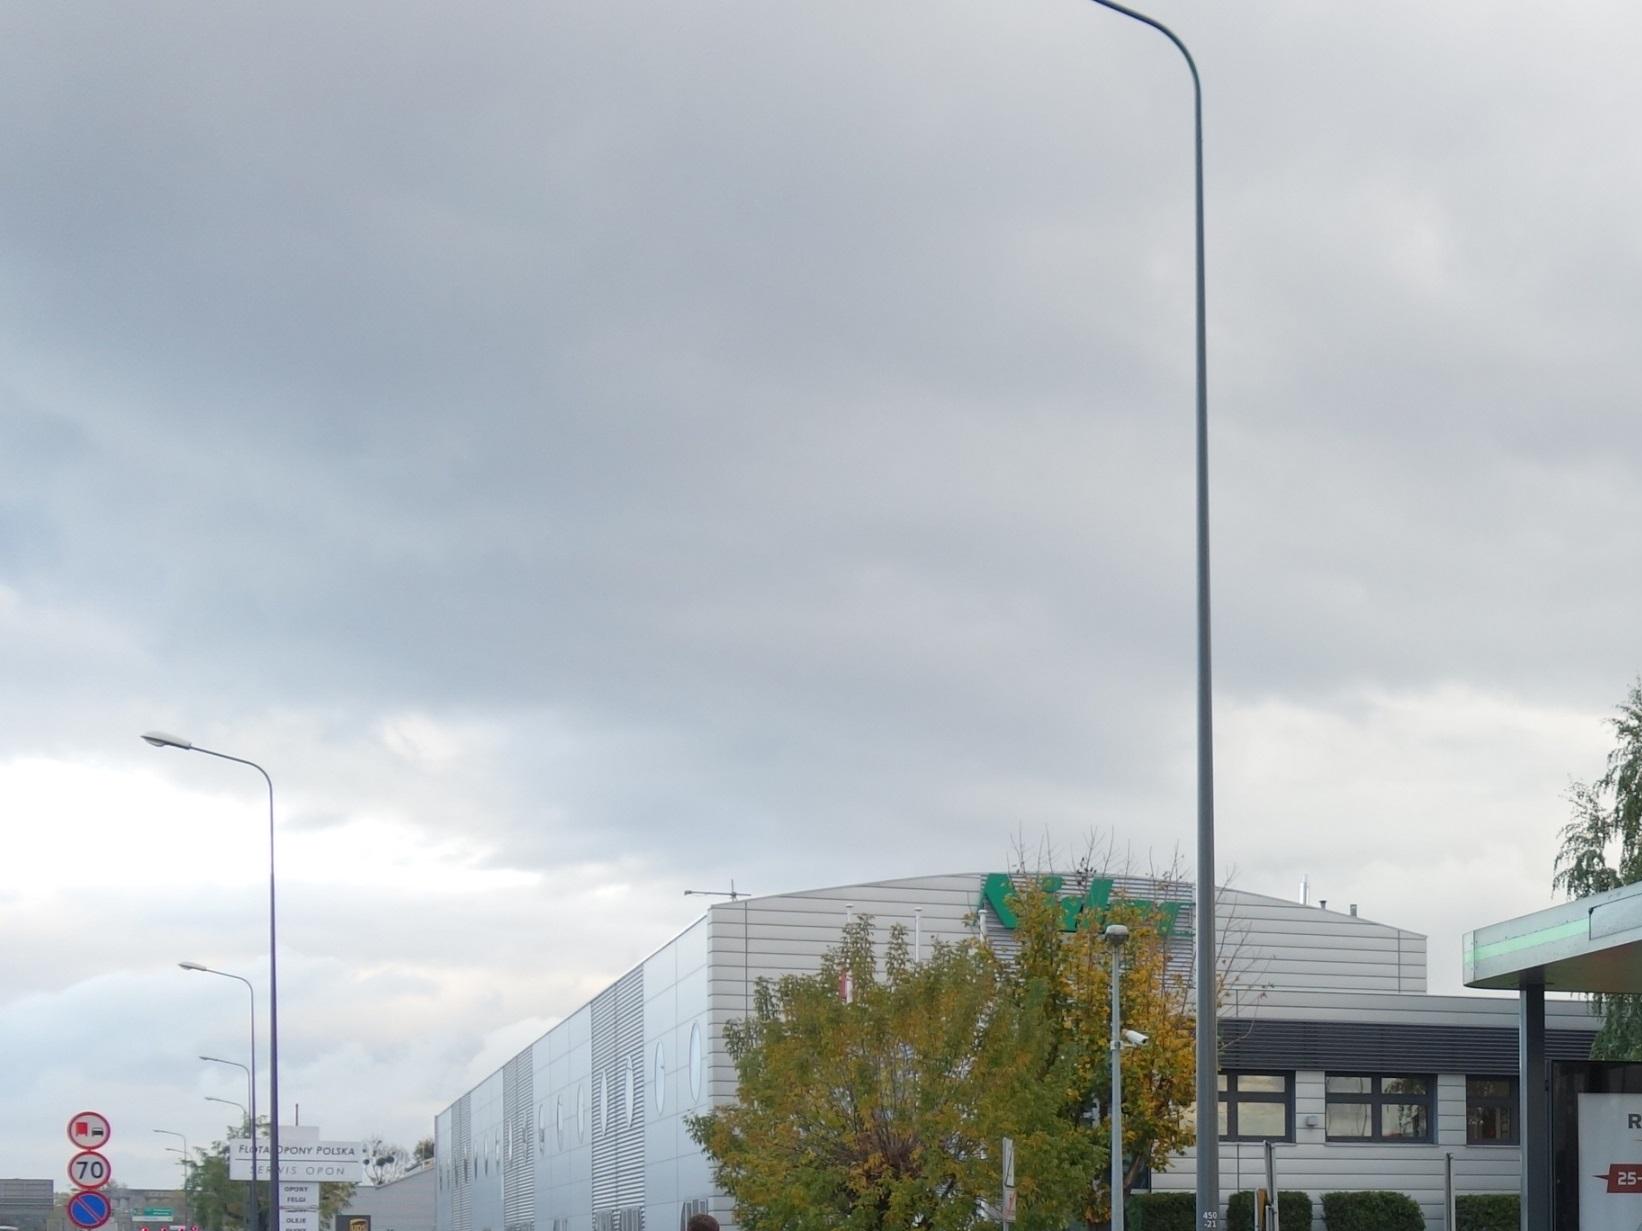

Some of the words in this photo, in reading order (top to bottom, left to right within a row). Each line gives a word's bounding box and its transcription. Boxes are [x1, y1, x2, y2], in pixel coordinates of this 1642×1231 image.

[316, 1145, 356, 1156] POLSKA
[76, 1161, 104, 1179] 70
[305, 1166, 345, 1176] OPON
[1203, 1211, 1218, 1219] 450
